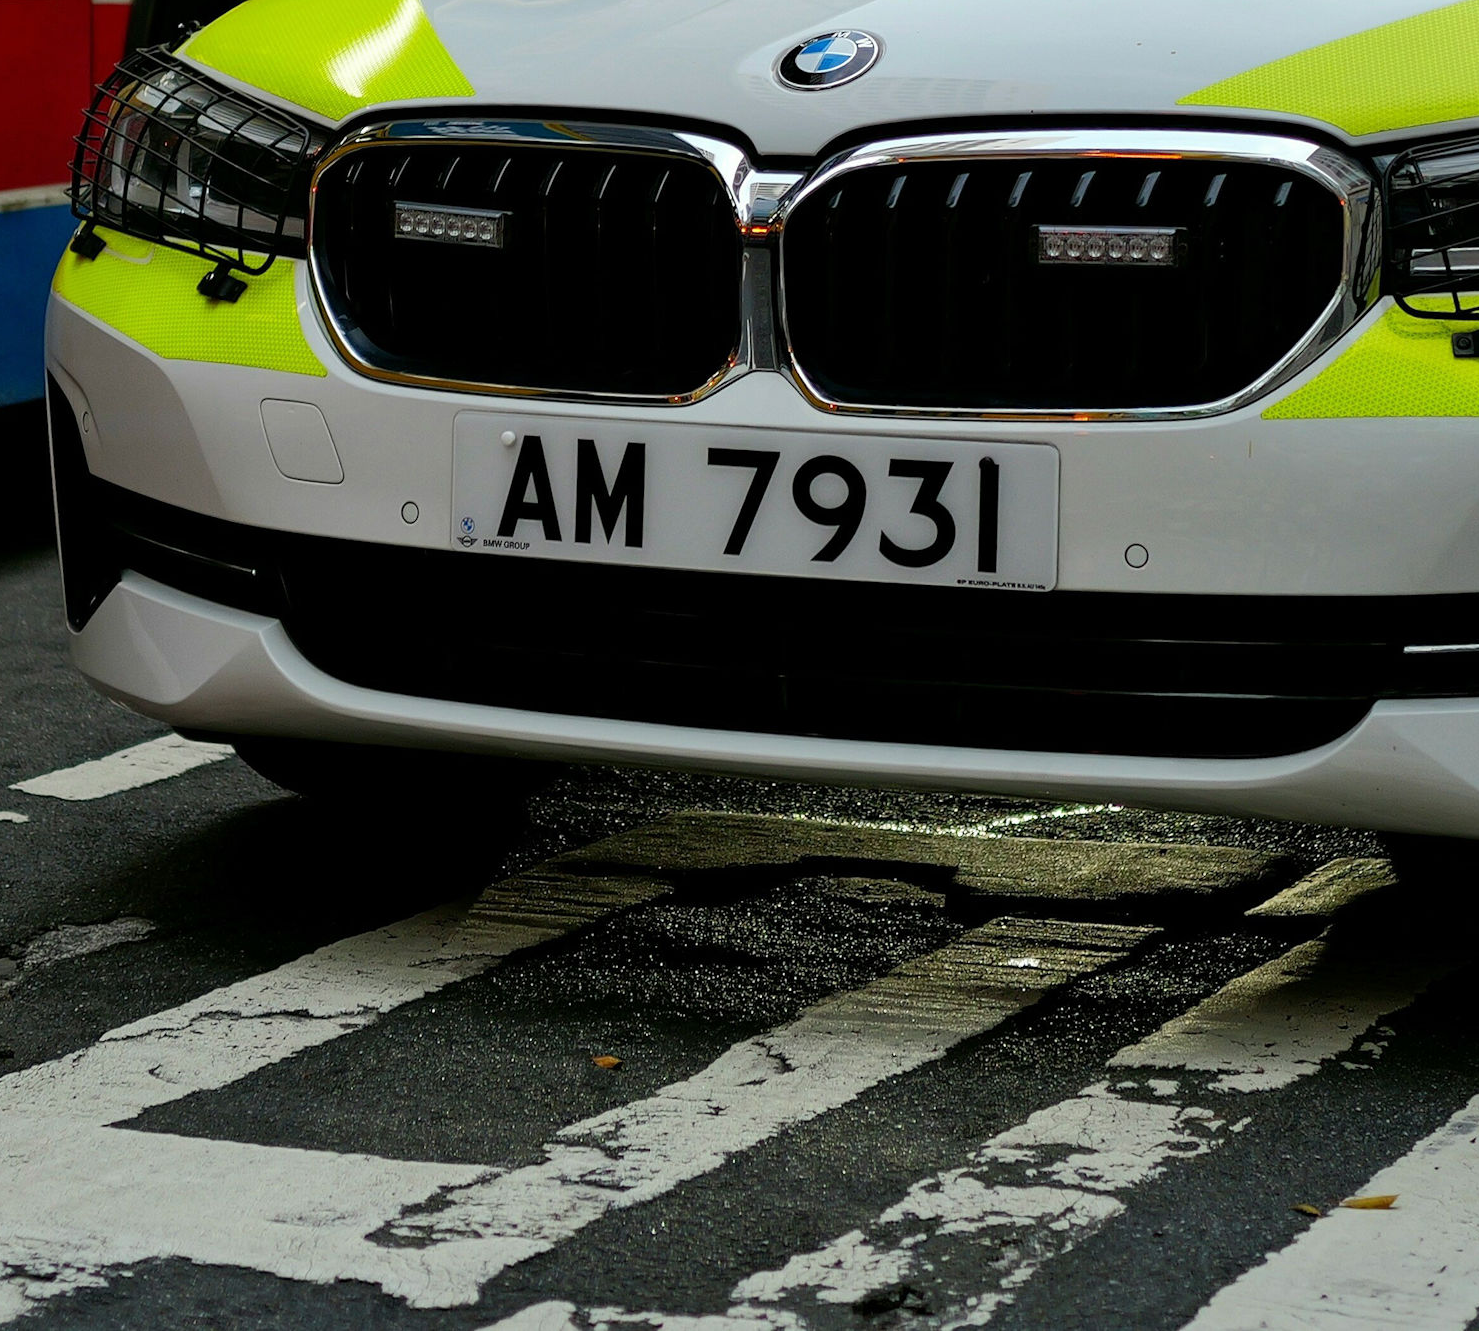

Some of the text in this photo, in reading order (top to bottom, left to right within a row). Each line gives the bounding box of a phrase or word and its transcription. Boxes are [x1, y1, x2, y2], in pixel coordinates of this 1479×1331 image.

[496, 435, 1000, 574] AM 7931
[483, 539, 503, 548] BMW
[503, 540, 531, 550] GROUP
[968, 580, 1016, 589] EURO-PLATE
